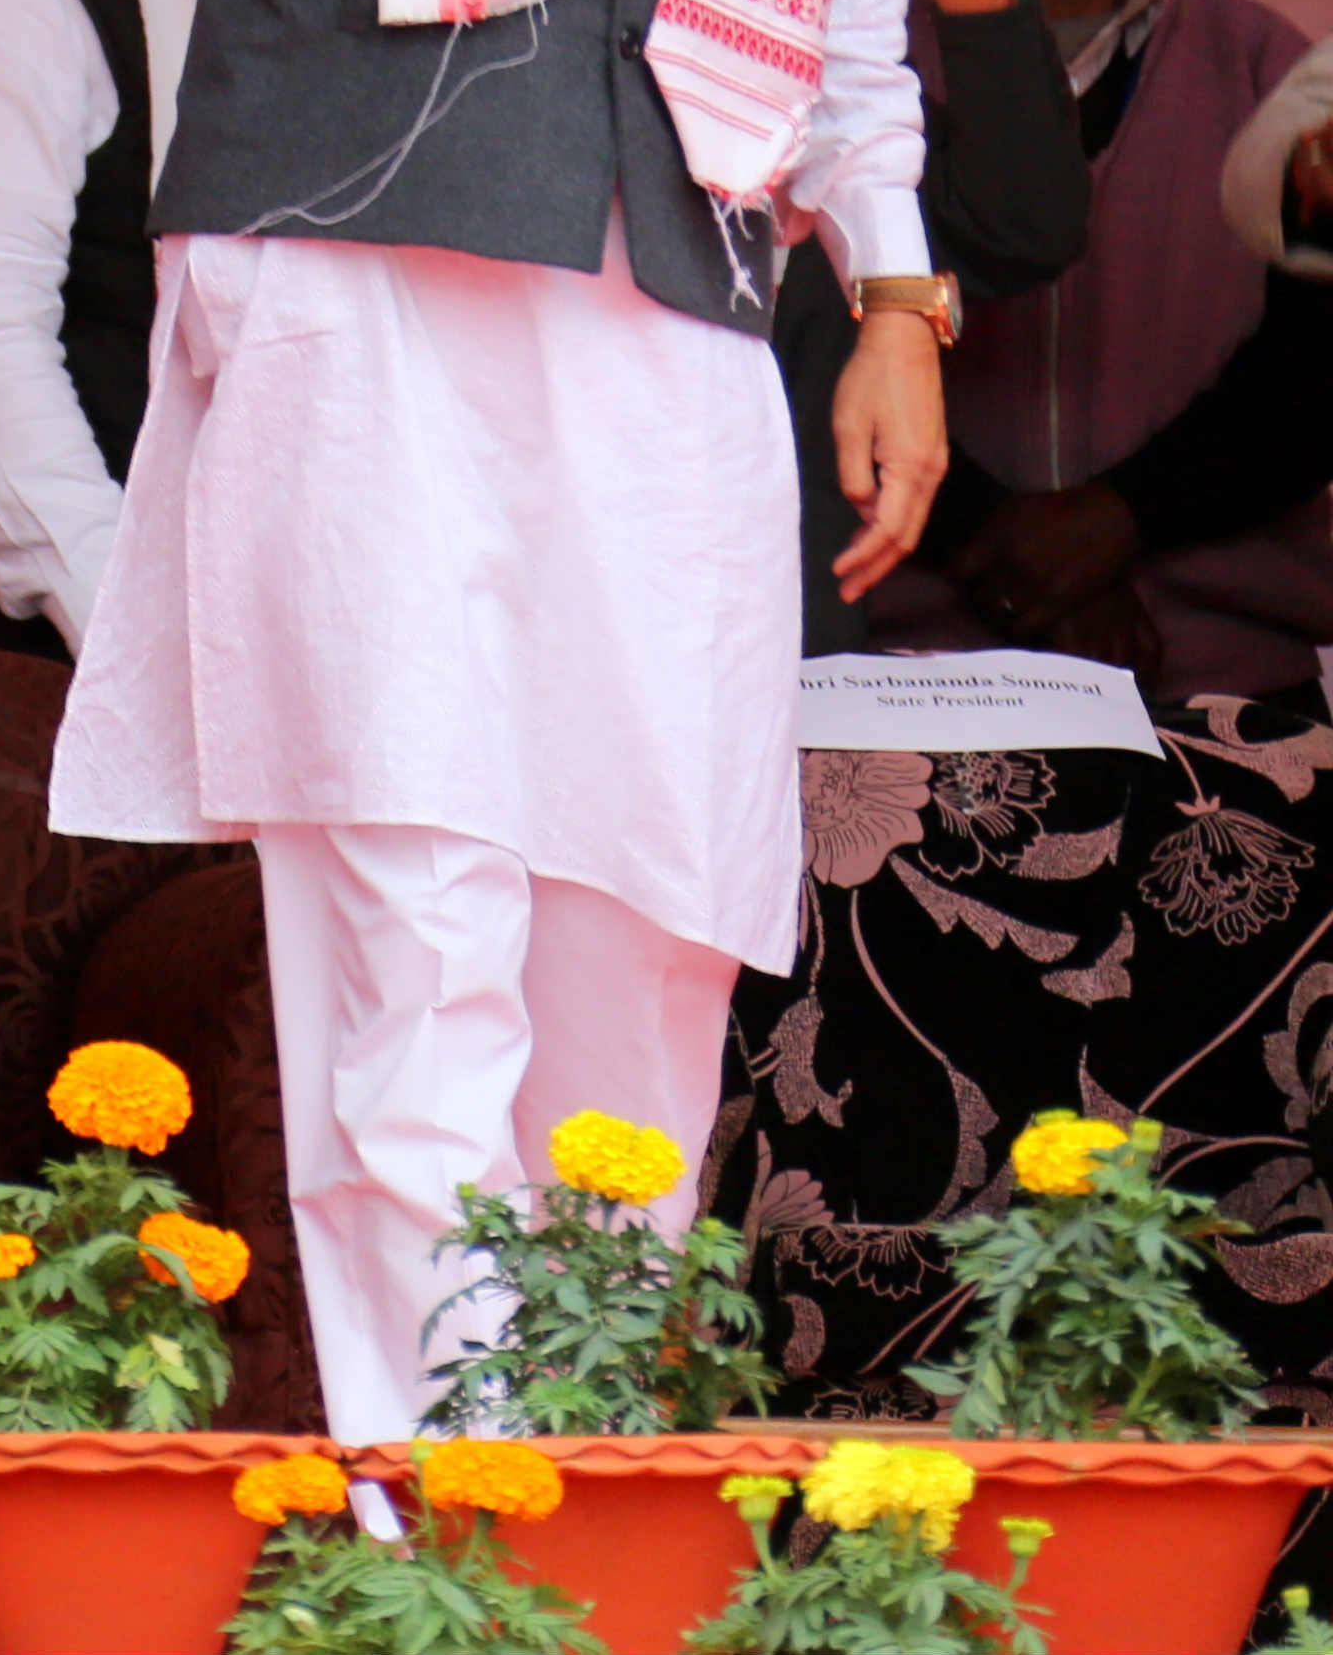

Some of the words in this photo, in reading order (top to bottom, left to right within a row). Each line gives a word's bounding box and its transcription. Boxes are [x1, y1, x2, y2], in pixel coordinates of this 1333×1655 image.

[799, 676, 836, 690] hri
[843, 674, 994, 689] Sarbananda
[1001, 673, 1102, 696] Sonowal
[876, 695, 926, 707] State
[932, 694, 1025, 707] President
